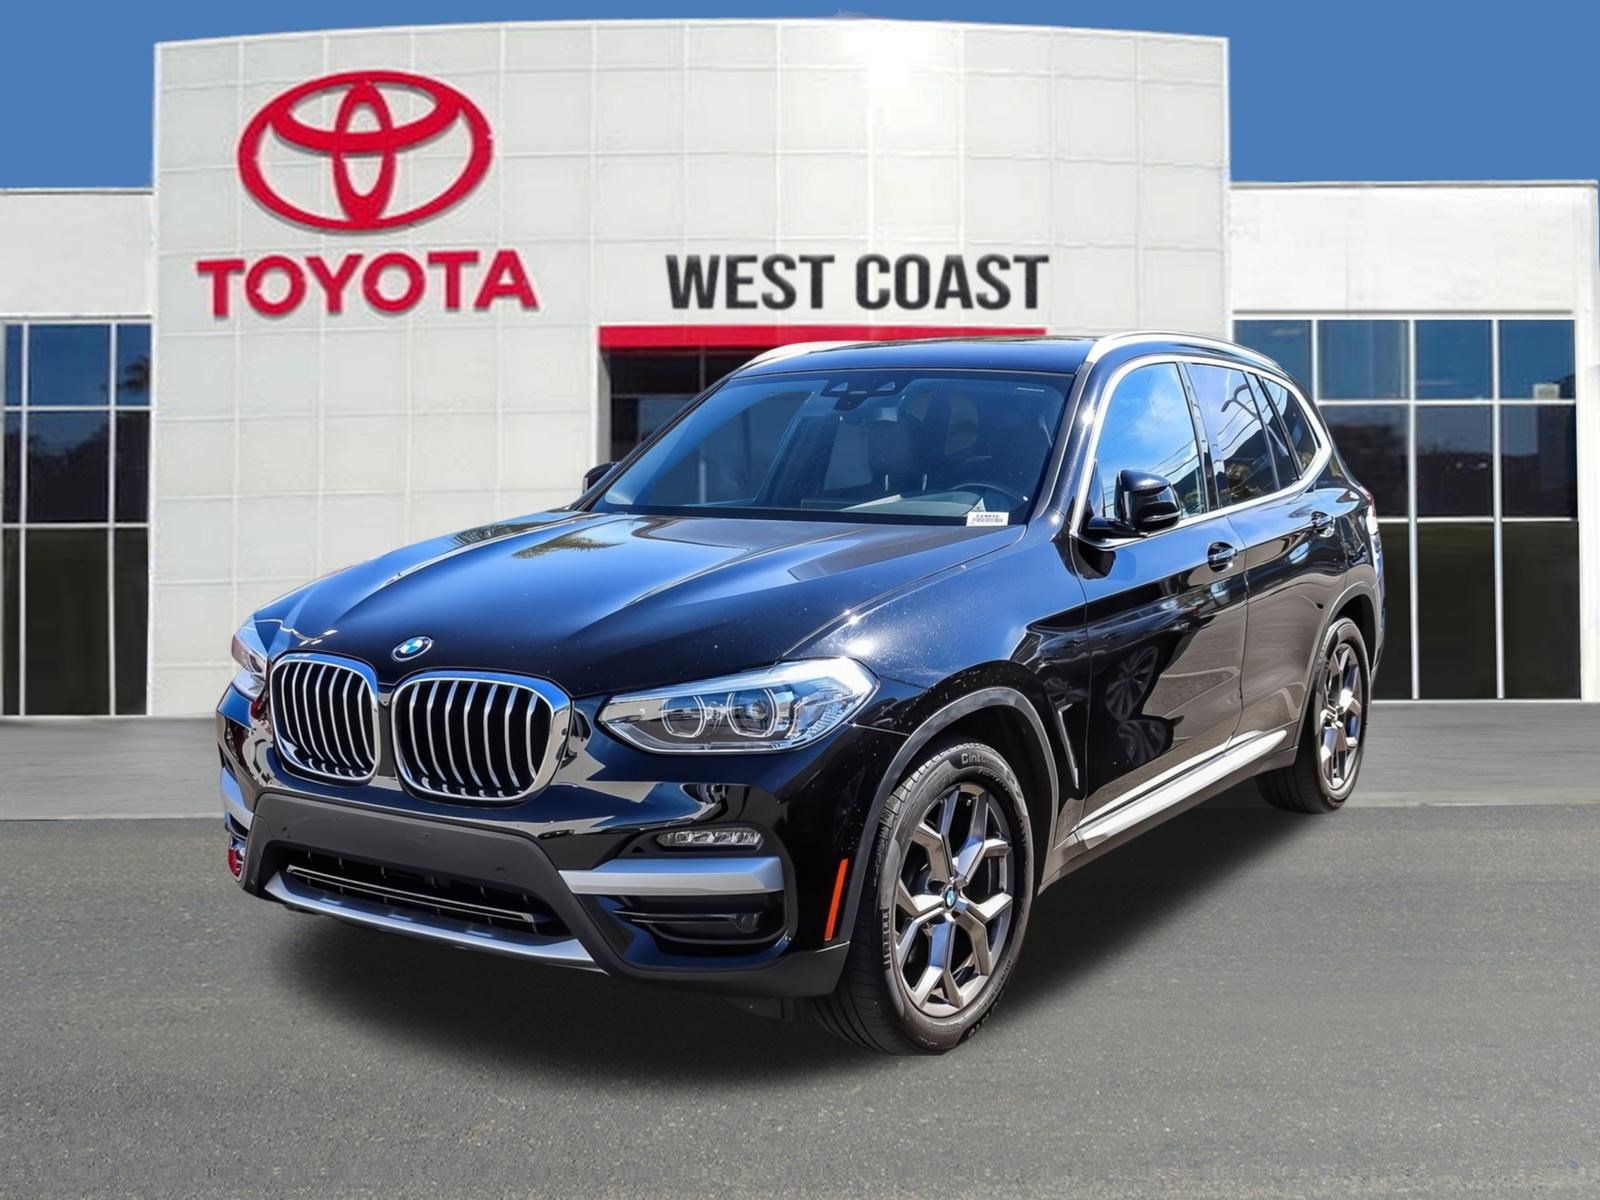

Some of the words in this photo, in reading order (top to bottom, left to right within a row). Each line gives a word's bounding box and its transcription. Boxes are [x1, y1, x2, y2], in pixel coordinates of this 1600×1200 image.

[196, 249, 539, 318] TOYOTA
[666, 254, 834, 310] WEST
[855, 254, 1049, 310] COAST
